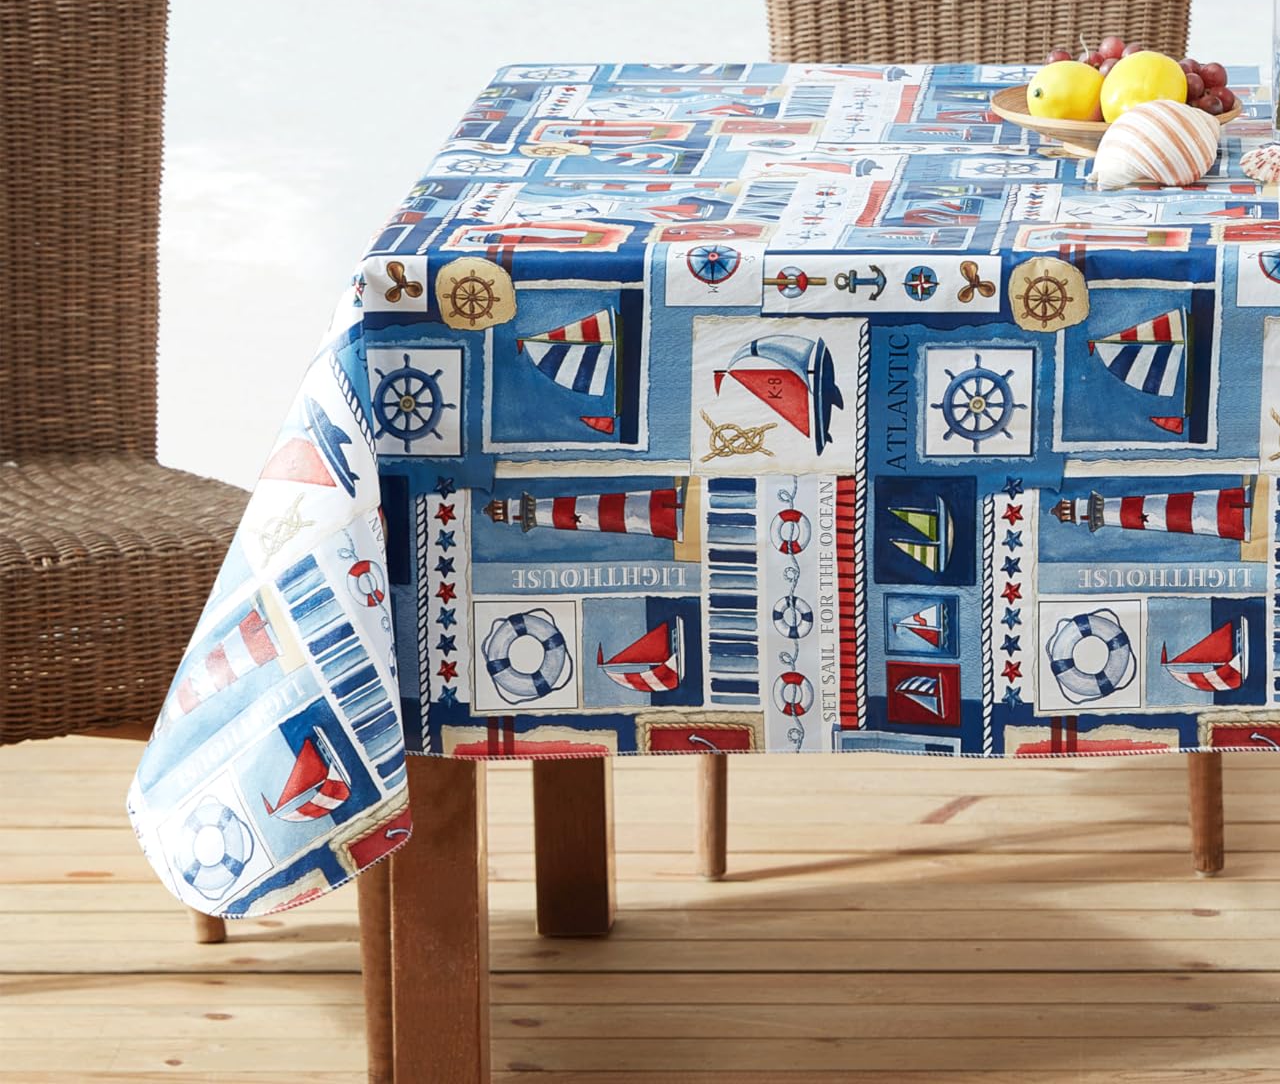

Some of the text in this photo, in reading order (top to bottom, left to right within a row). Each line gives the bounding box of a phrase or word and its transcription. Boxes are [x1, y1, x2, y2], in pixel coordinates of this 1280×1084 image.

[767, 377, 783, 400] K-8
[886, 333, 910, 472] ATLANTIC
[511, 566, 687, 589] LIGHTHOUSE
[1078, 567, 1253, 589] LIGHTHOUSE
[819, 481, 837, 723] SET SAIL FOR THE OCEAN
